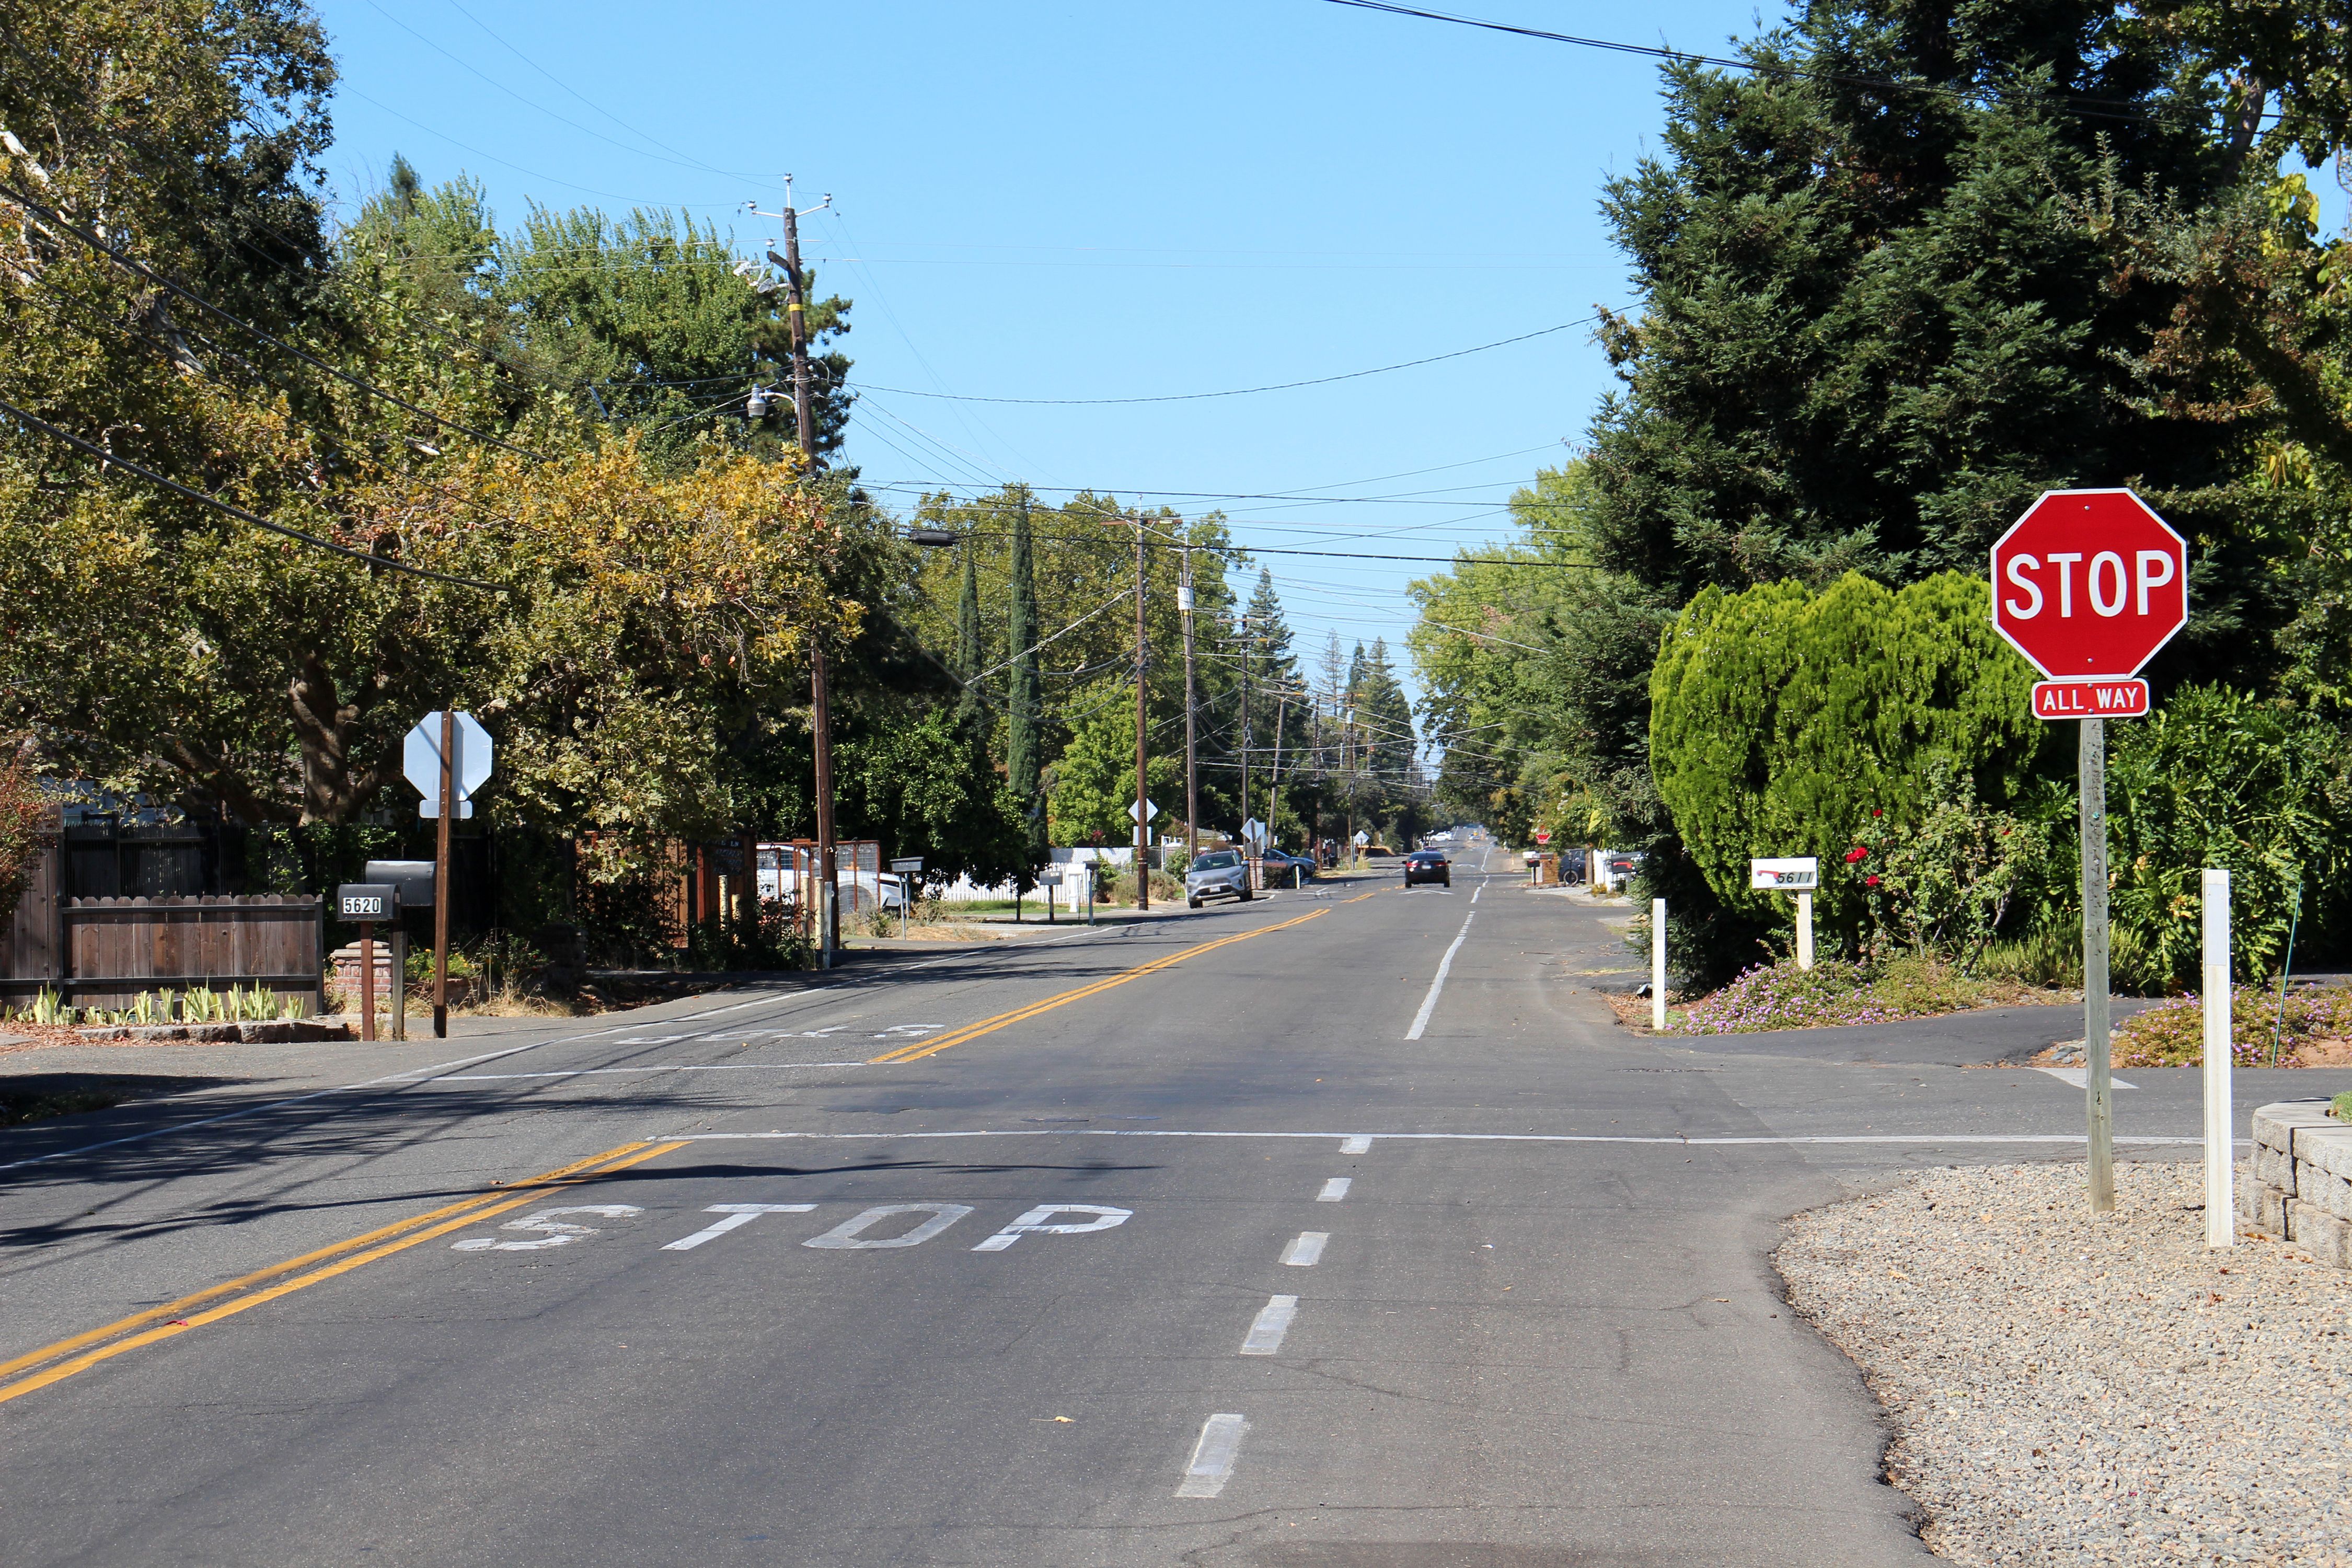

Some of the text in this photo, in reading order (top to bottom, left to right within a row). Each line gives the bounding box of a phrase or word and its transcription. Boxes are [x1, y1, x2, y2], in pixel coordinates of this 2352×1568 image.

[2005, 550, 2174, 620] STOP
[2042, 687, 2138, 711] ALL WAY
[1777, 872, 1812, 883] 5611
[345, 898, 379, 913] 5620
[451, 1204, 1134, 1252] STOP
